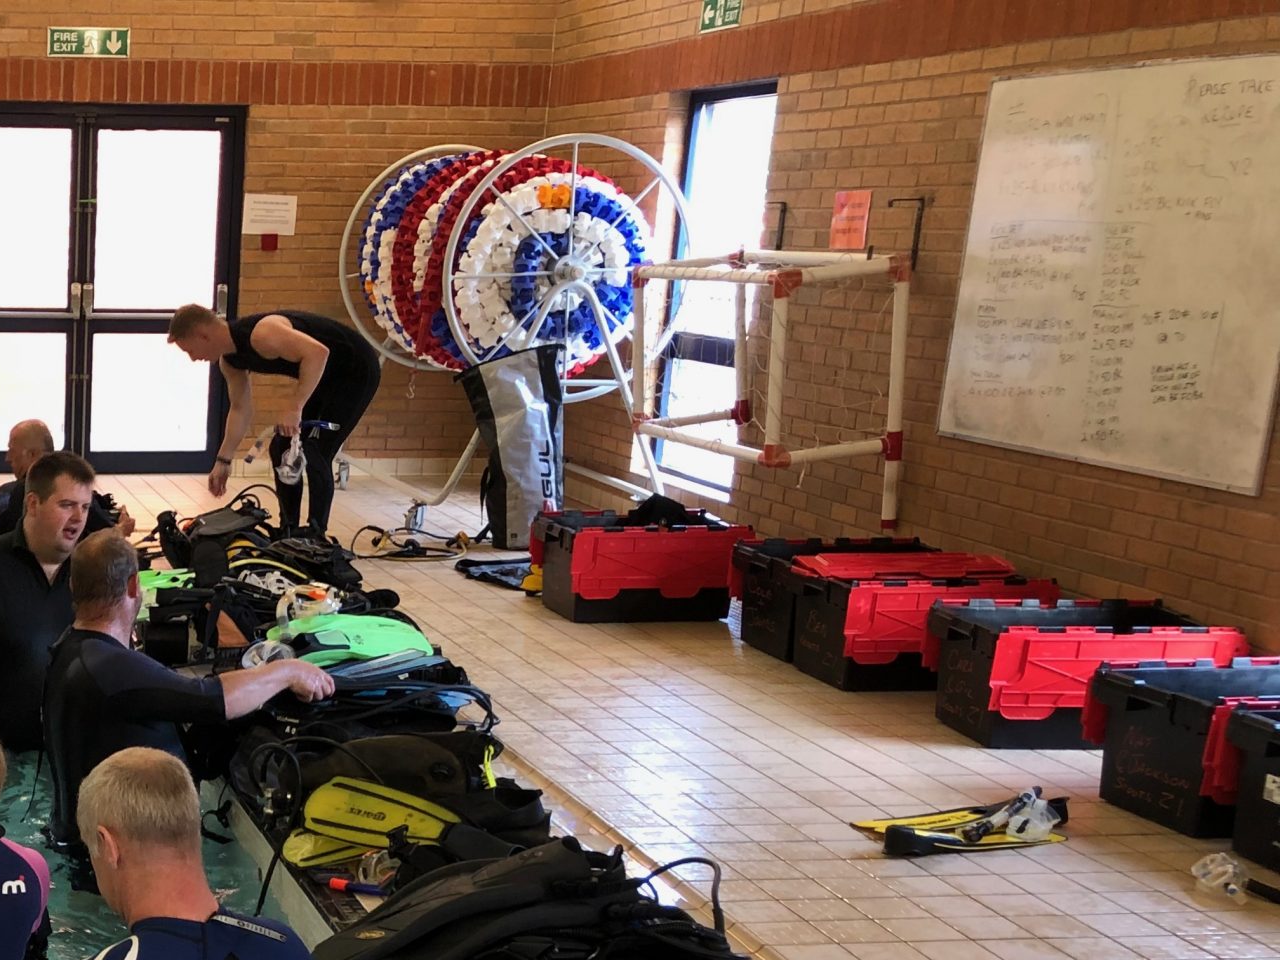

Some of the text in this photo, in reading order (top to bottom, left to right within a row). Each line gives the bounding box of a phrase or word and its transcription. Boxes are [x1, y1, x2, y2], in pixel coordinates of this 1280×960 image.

[53, 32, 78, 41] FIRE
[53, 43, 78, 52] EXIT
[538, 439, 553, 498] GUL
